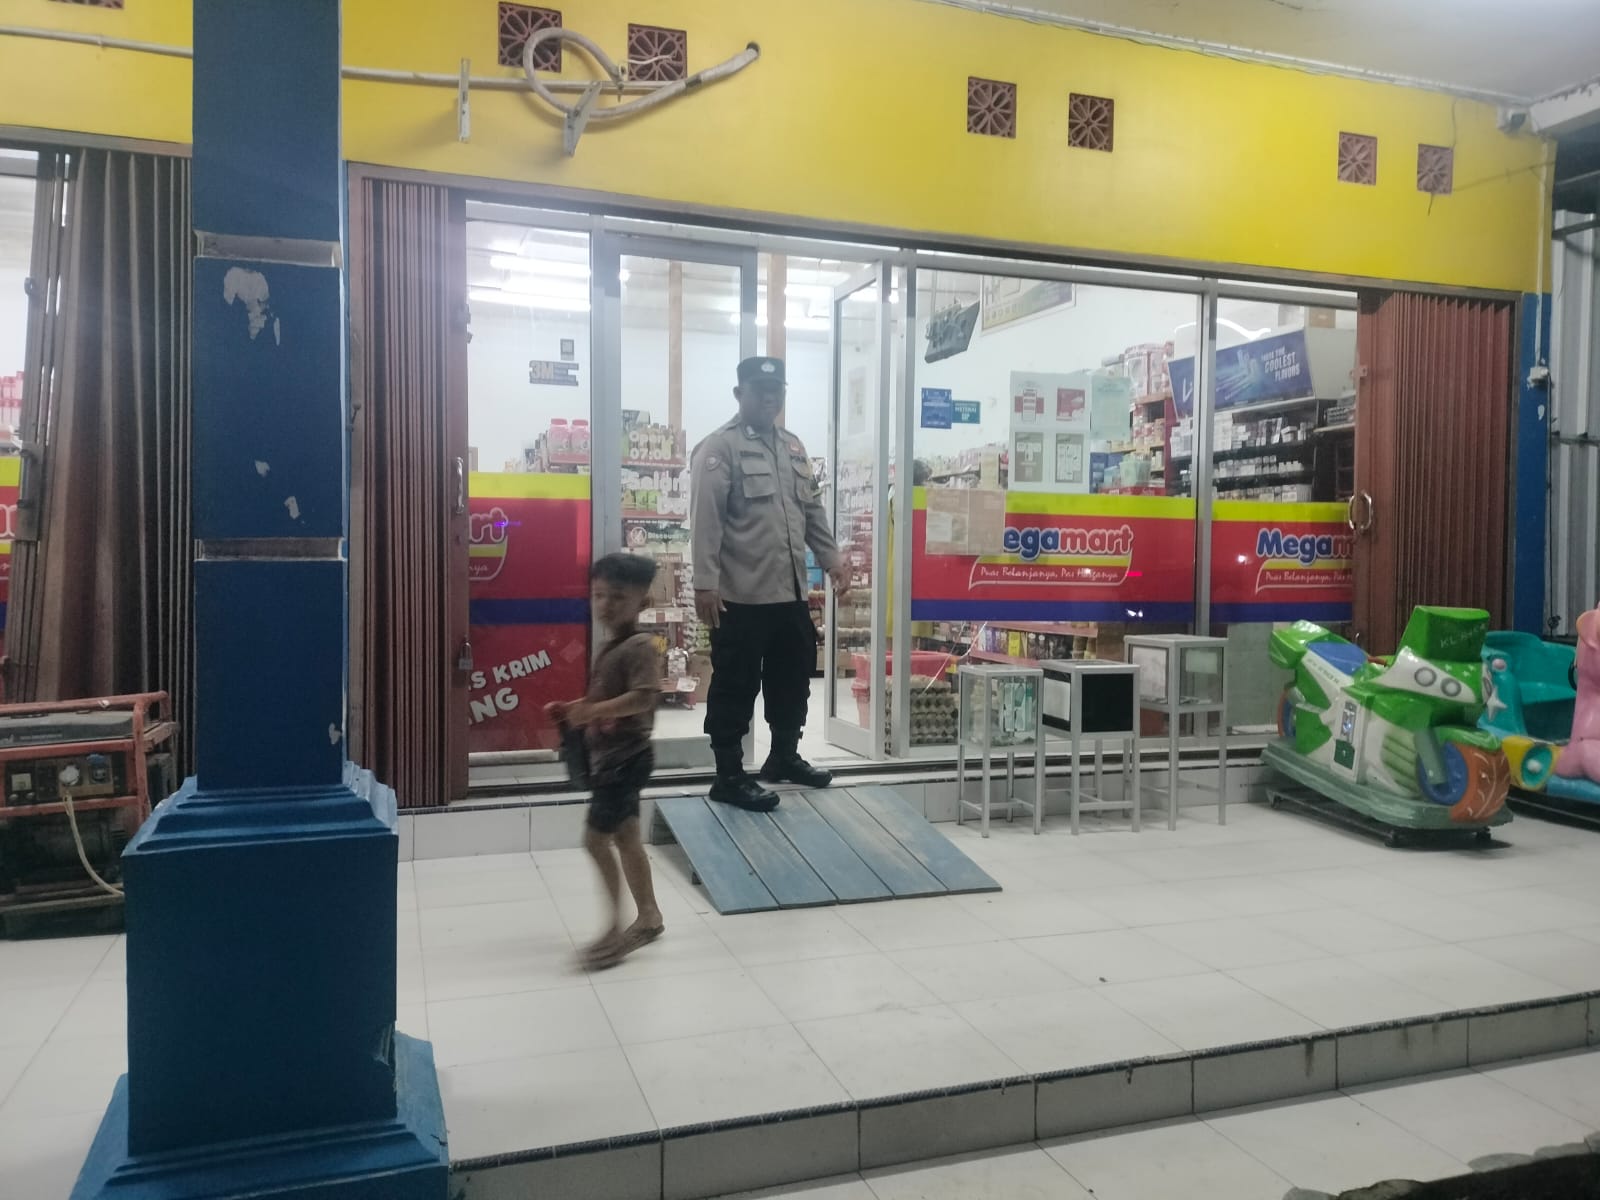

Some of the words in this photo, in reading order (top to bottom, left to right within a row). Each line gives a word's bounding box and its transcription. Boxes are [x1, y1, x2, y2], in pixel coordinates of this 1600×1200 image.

[1264, 351, 1296, 374] COOLEST
[1003, 524, 1134, 561] egamart
[1256, 528, 1354, 566] Megam
[468, 671, 487, 691] S
[492, 649, 552, 684] KRIM
[468, 687, 519, 725] NG
